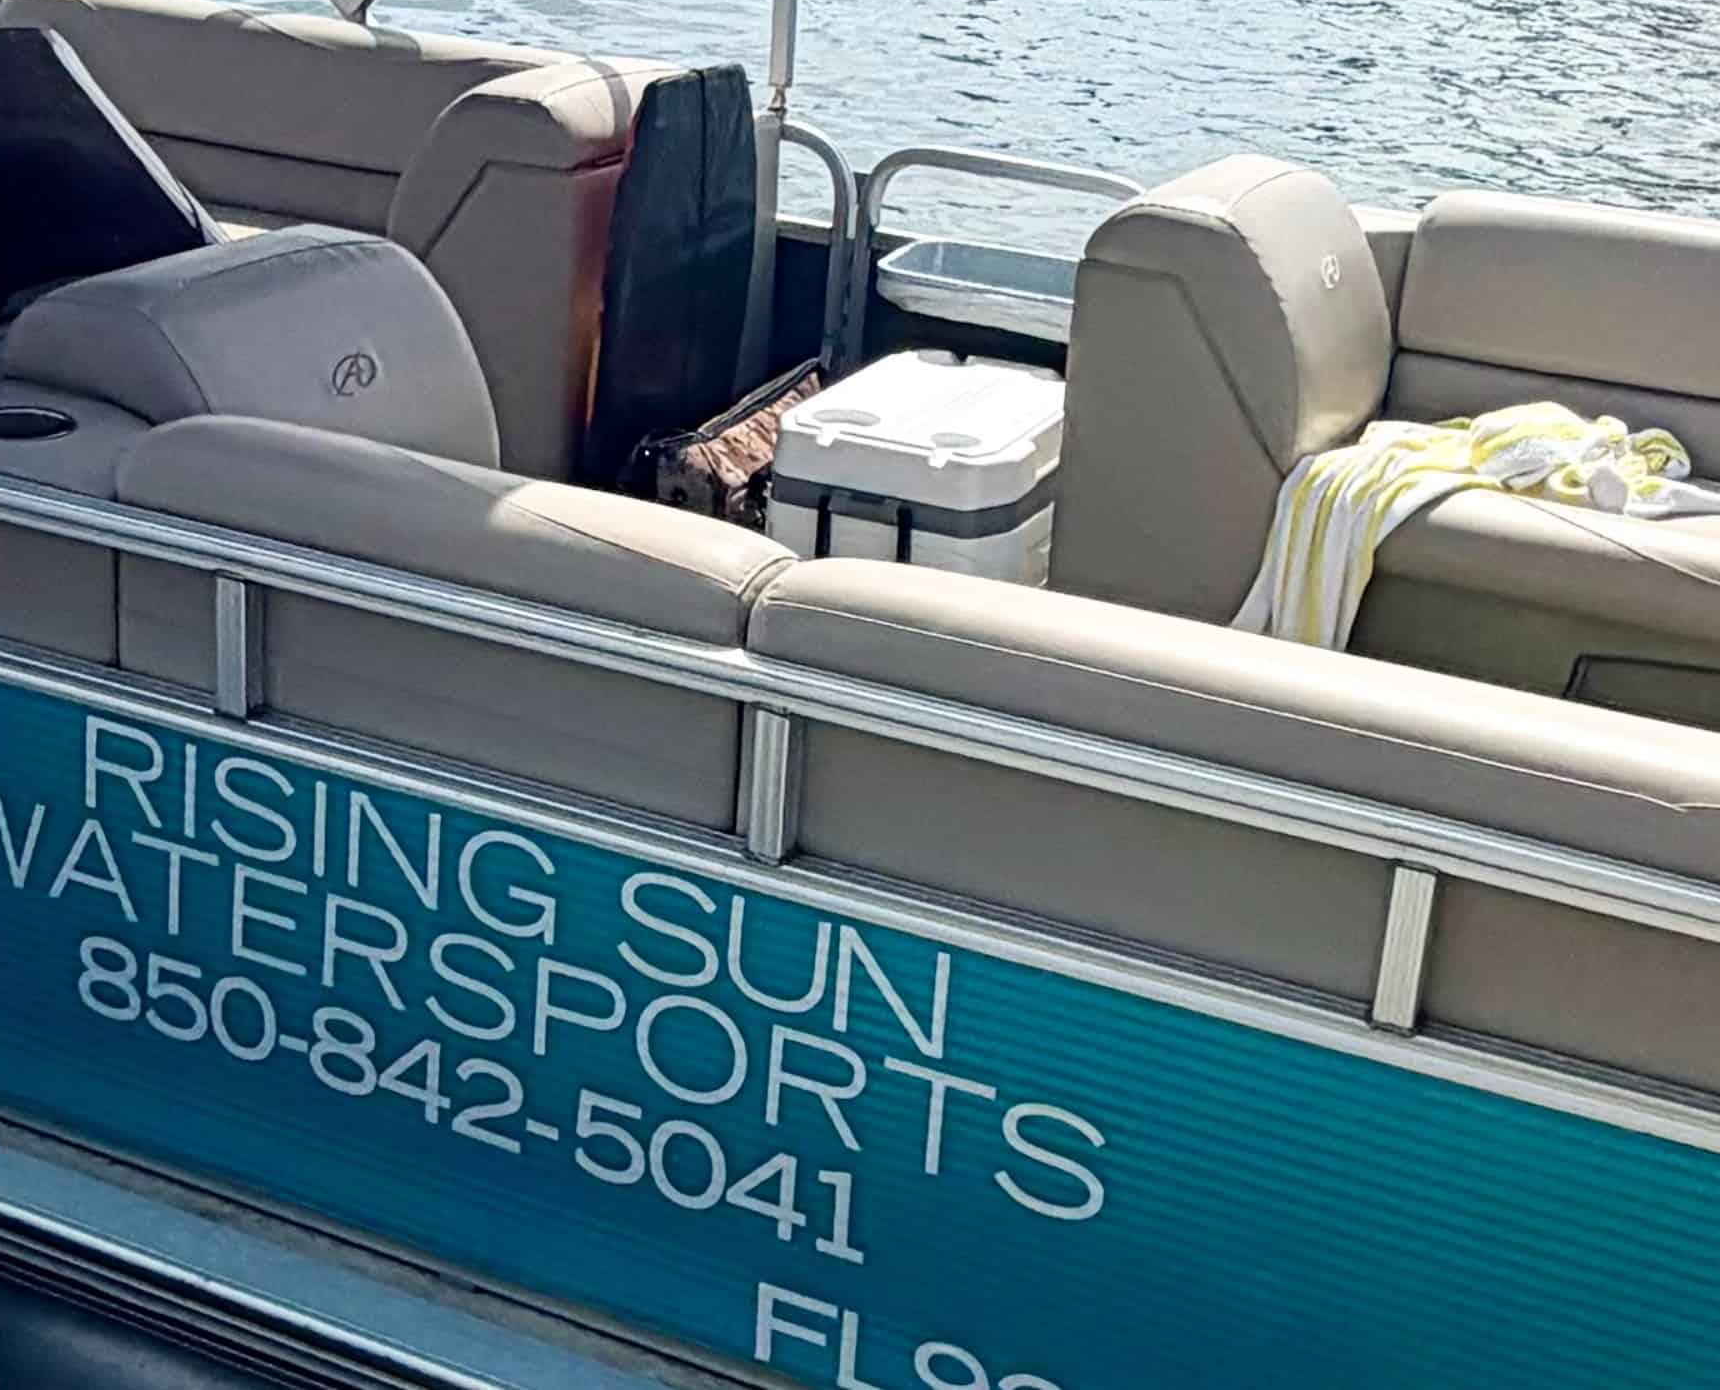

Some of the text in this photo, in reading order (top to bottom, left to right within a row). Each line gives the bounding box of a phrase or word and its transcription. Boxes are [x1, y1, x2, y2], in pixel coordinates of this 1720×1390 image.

[84, 714, 951, 1060] RISING SUN
[78, 935, 865, 1265] 850-842-5041
[753, 1280, 1068, 1390] FL9
